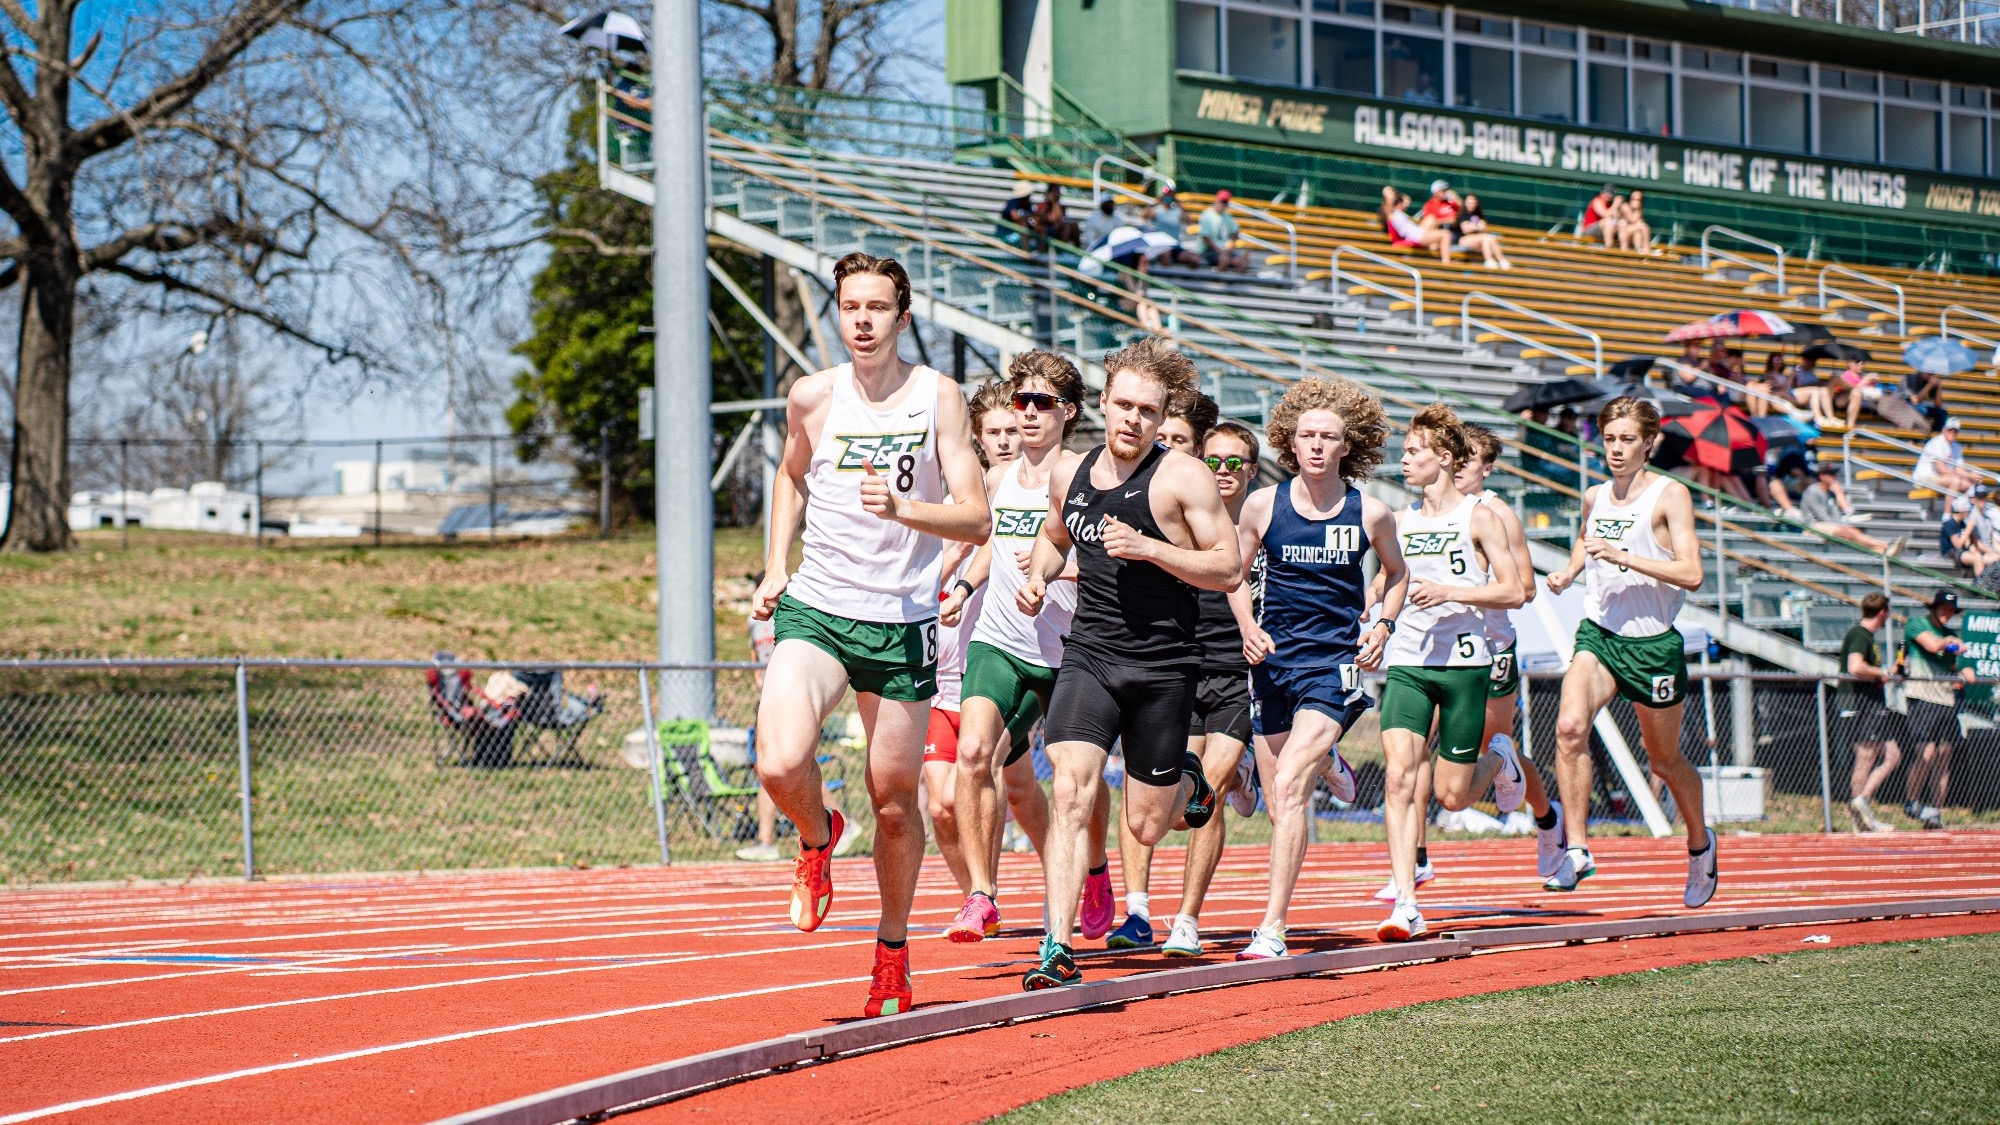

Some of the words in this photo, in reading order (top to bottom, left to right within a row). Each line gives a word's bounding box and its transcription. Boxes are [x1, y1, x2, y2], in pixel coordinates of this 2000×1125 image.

[1197, 89, 1263, 126] MINER
[1266, 98, 1328, 134] PRIDE
[1354, 105, 1555, 168] ALLGOOD-BAILEY
[1561, 133, 1660, 180] STADIUM
[1683, 148, 1743, 191] HOME
[1750, 157, 1778, 194] OF
[1785, 161, 1826, 200] THE
[1831, 167, 1907, 209] MINERS
[1925, 183, 1974, 214] MINER
[839, 434, 925, 468] S&T
[896, 454, 915, 493] 8
[996, 509, 1047, 536] S&T
[1066, 511, 1118, 542] Val
[1594, 519, 1634, 539] S&T
[1332, 527, 1352, 550] 11
[1404, 533, 1458, 555] S&T
[1281, 544, 1350, 565] PRINCIPIA
[1449, 550, 1466, 575] 5
[927, 623, 937, 661] 8
[1457, 632, 1475, 658] 5
[1346, 665, 1360, 688] 11
[1497, 657, 1508, 678] 9
[1657, 678, 1669, 700] 6
